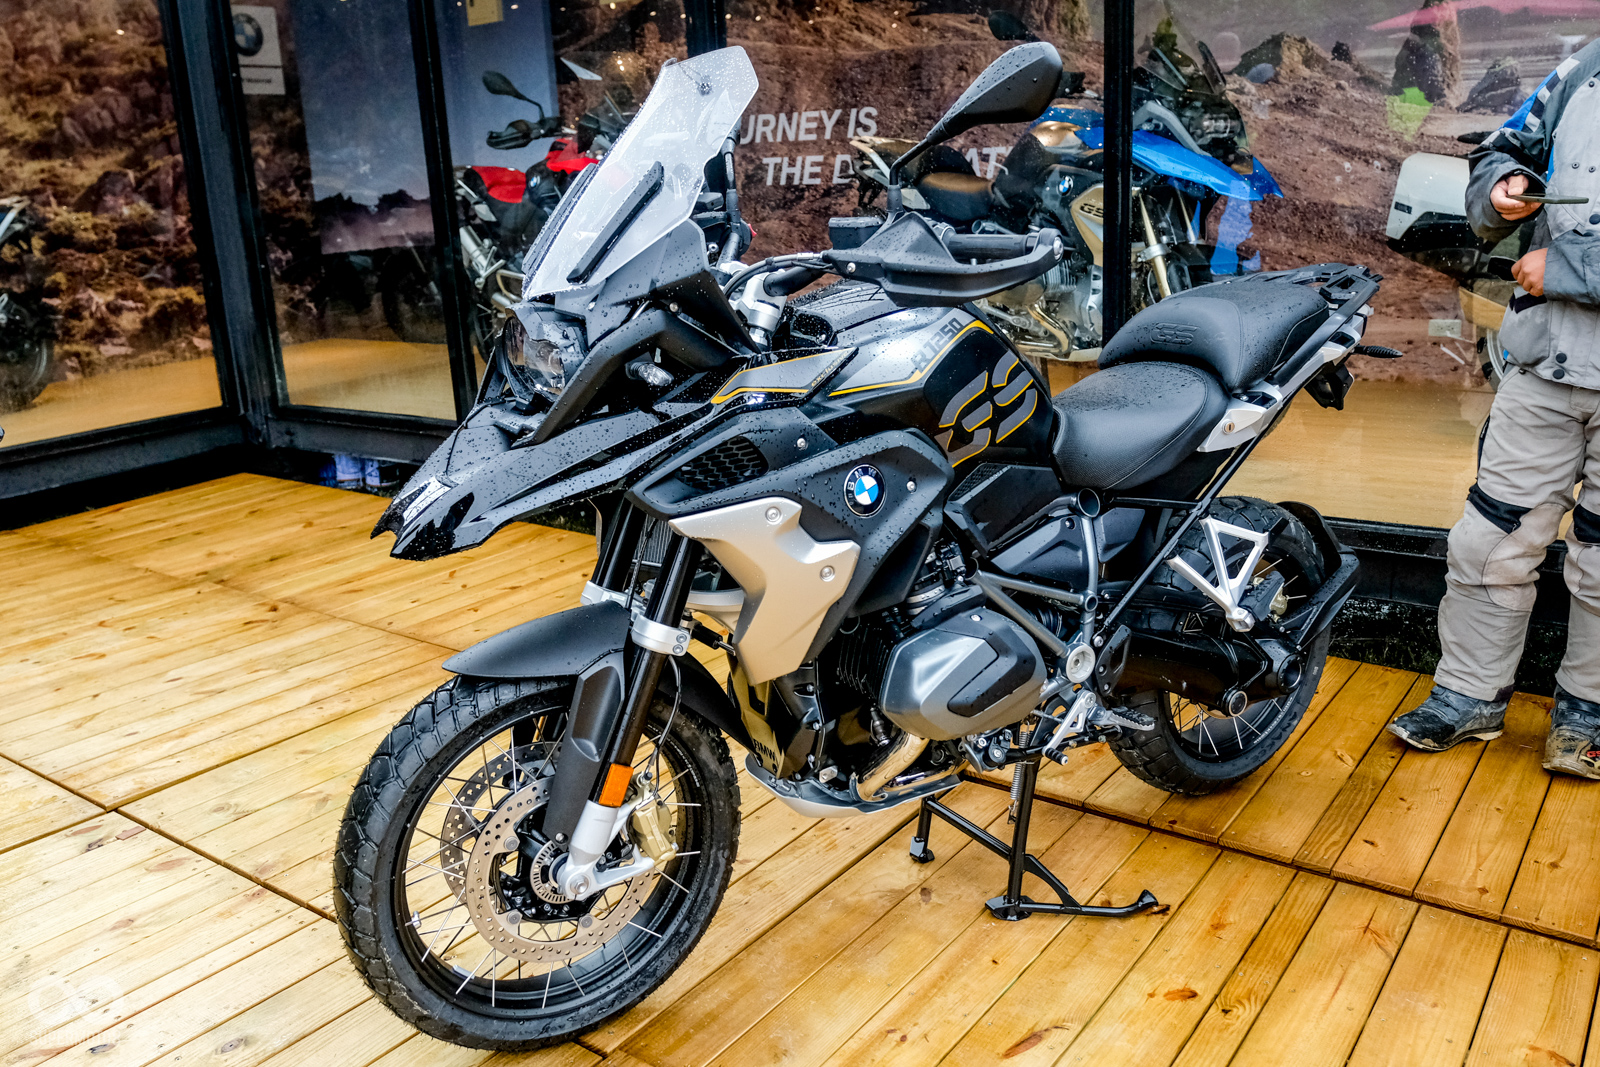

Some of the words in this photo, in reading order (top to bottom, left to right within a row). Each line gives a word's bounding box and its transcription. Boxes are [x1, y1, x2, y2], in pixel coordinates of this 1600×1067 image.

[847, 107, 878, 138] IS
[762, 155, 824, 186] THE
[1150, 322, 1200, 346] GS
